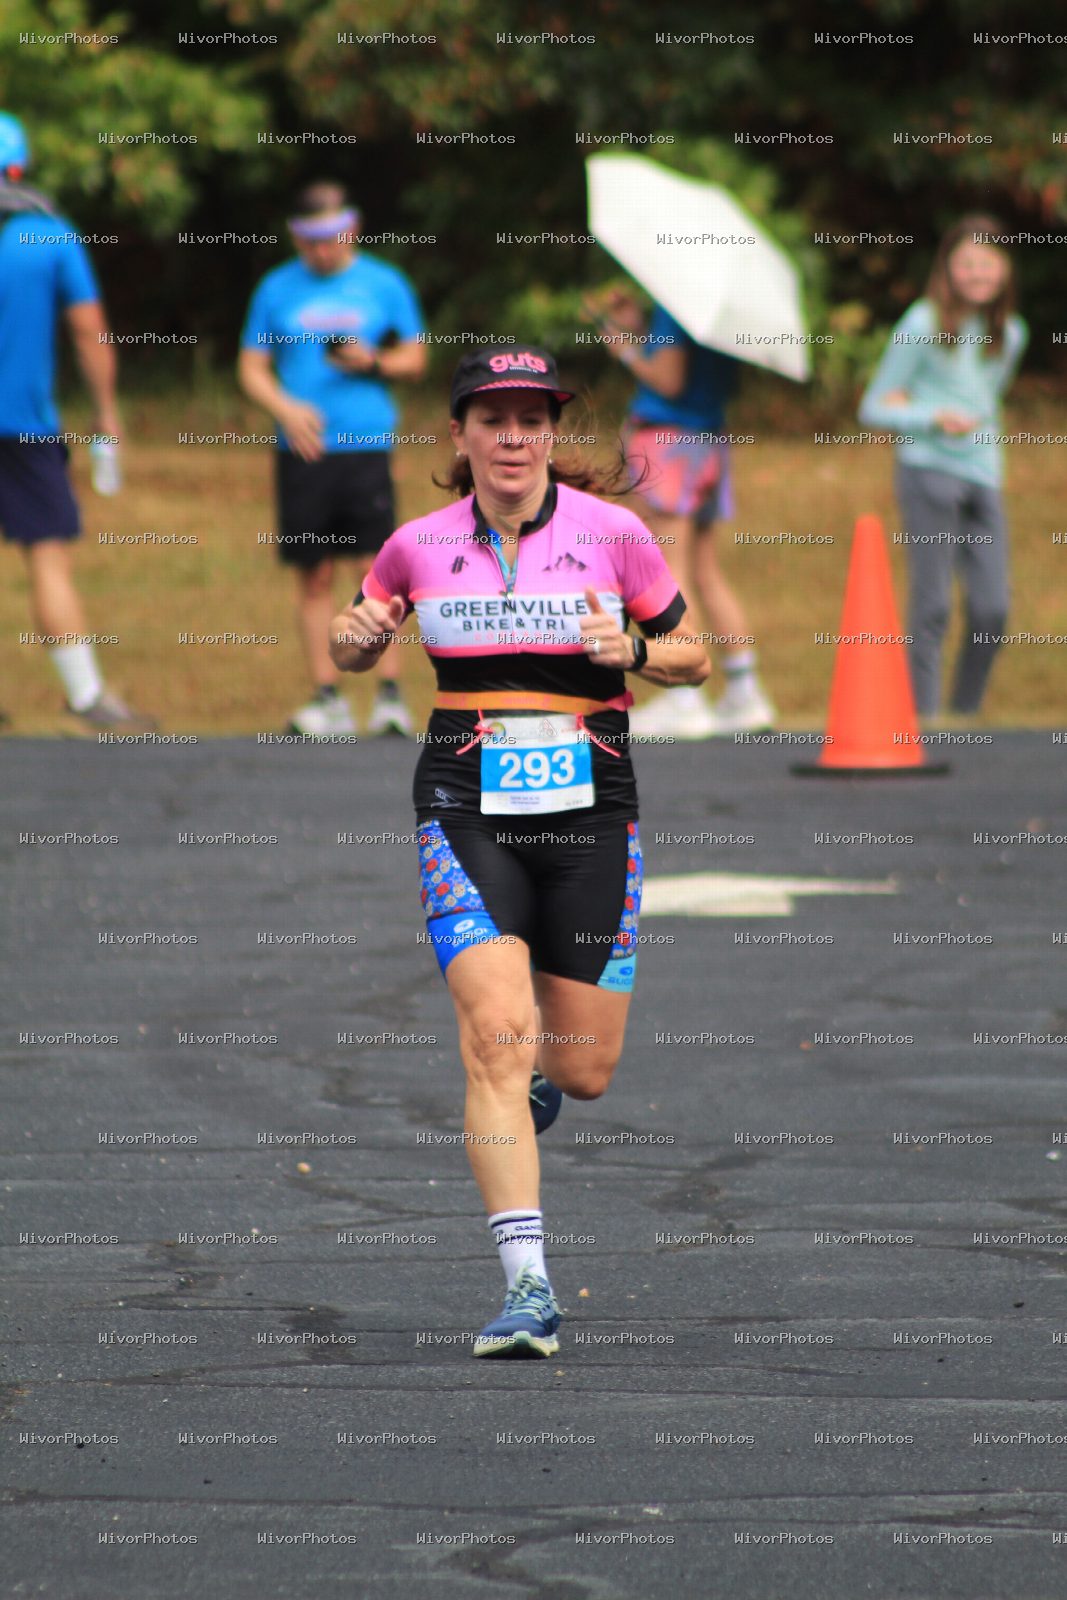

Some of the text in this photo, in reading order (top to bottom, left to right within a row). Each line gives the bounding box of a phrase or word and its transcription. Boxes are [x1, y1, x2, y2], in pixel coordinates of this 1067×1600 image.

[489, 351, 548, 374] guts
[440, 599, 587, 618] GREENVILLE
[463, 617, 565, 631] BIKE & TRI
[499, 749, 576, 788] 293
